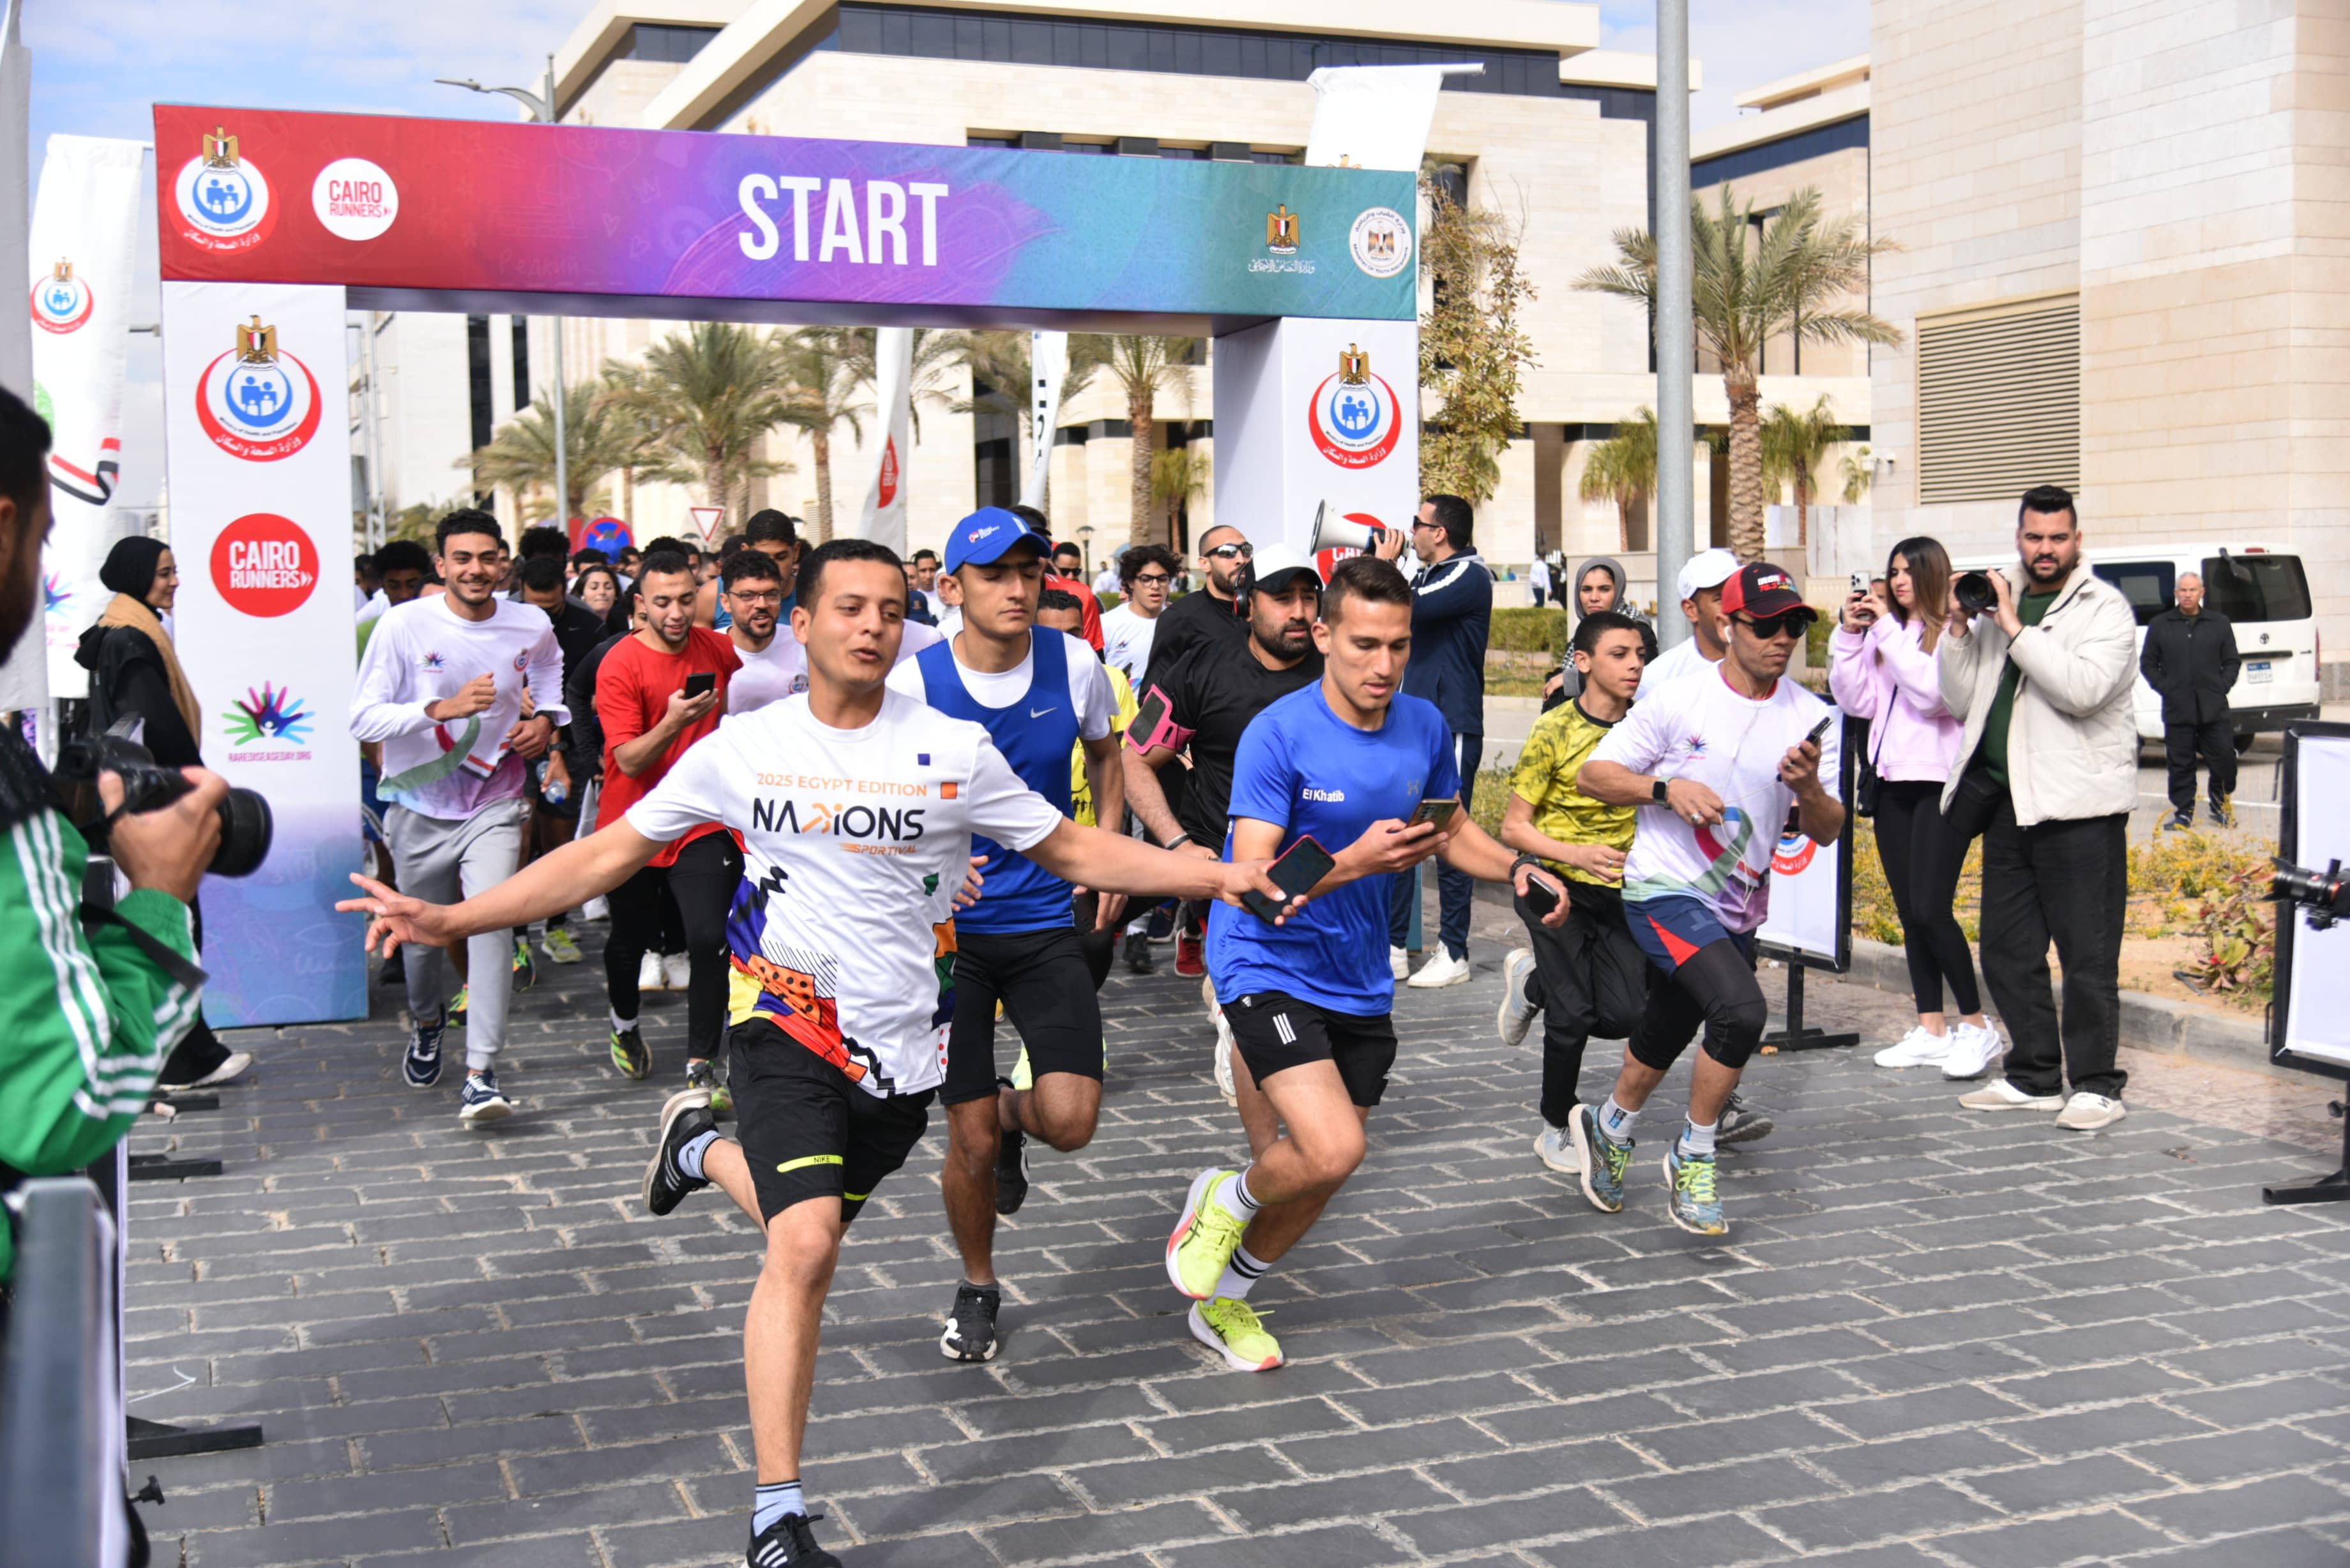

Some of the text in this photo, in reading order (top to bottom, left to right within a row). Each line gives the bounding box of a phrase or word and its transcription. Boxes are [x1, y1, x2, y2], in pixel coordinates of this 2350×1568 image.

[329, 179, 383, 204] CAIRO
[329, 202, 383, 218] RUNNERS
[738, 173, 949, 266] START
[240, 232, 261, 248] وزارة
[249, 446, 278, 457] الصحة
[277, 436, 303, 453] وزارة
[1347, 455, 1369, 465] الصحة
[1368, 446, 1386, 462] وزارة
[229, 540, 300, 570] CAIRO
[230, 569, 300, 589] RUNNERS
[228, 751, 312, 762] RAREDISEASEDAY.ORG
[757, 773, 928, 797] 2025 EGYPT EDITION
[1303, 788, 1345, 802] El Khatib
[854, 844, 918, 856] SPORTIVAL
